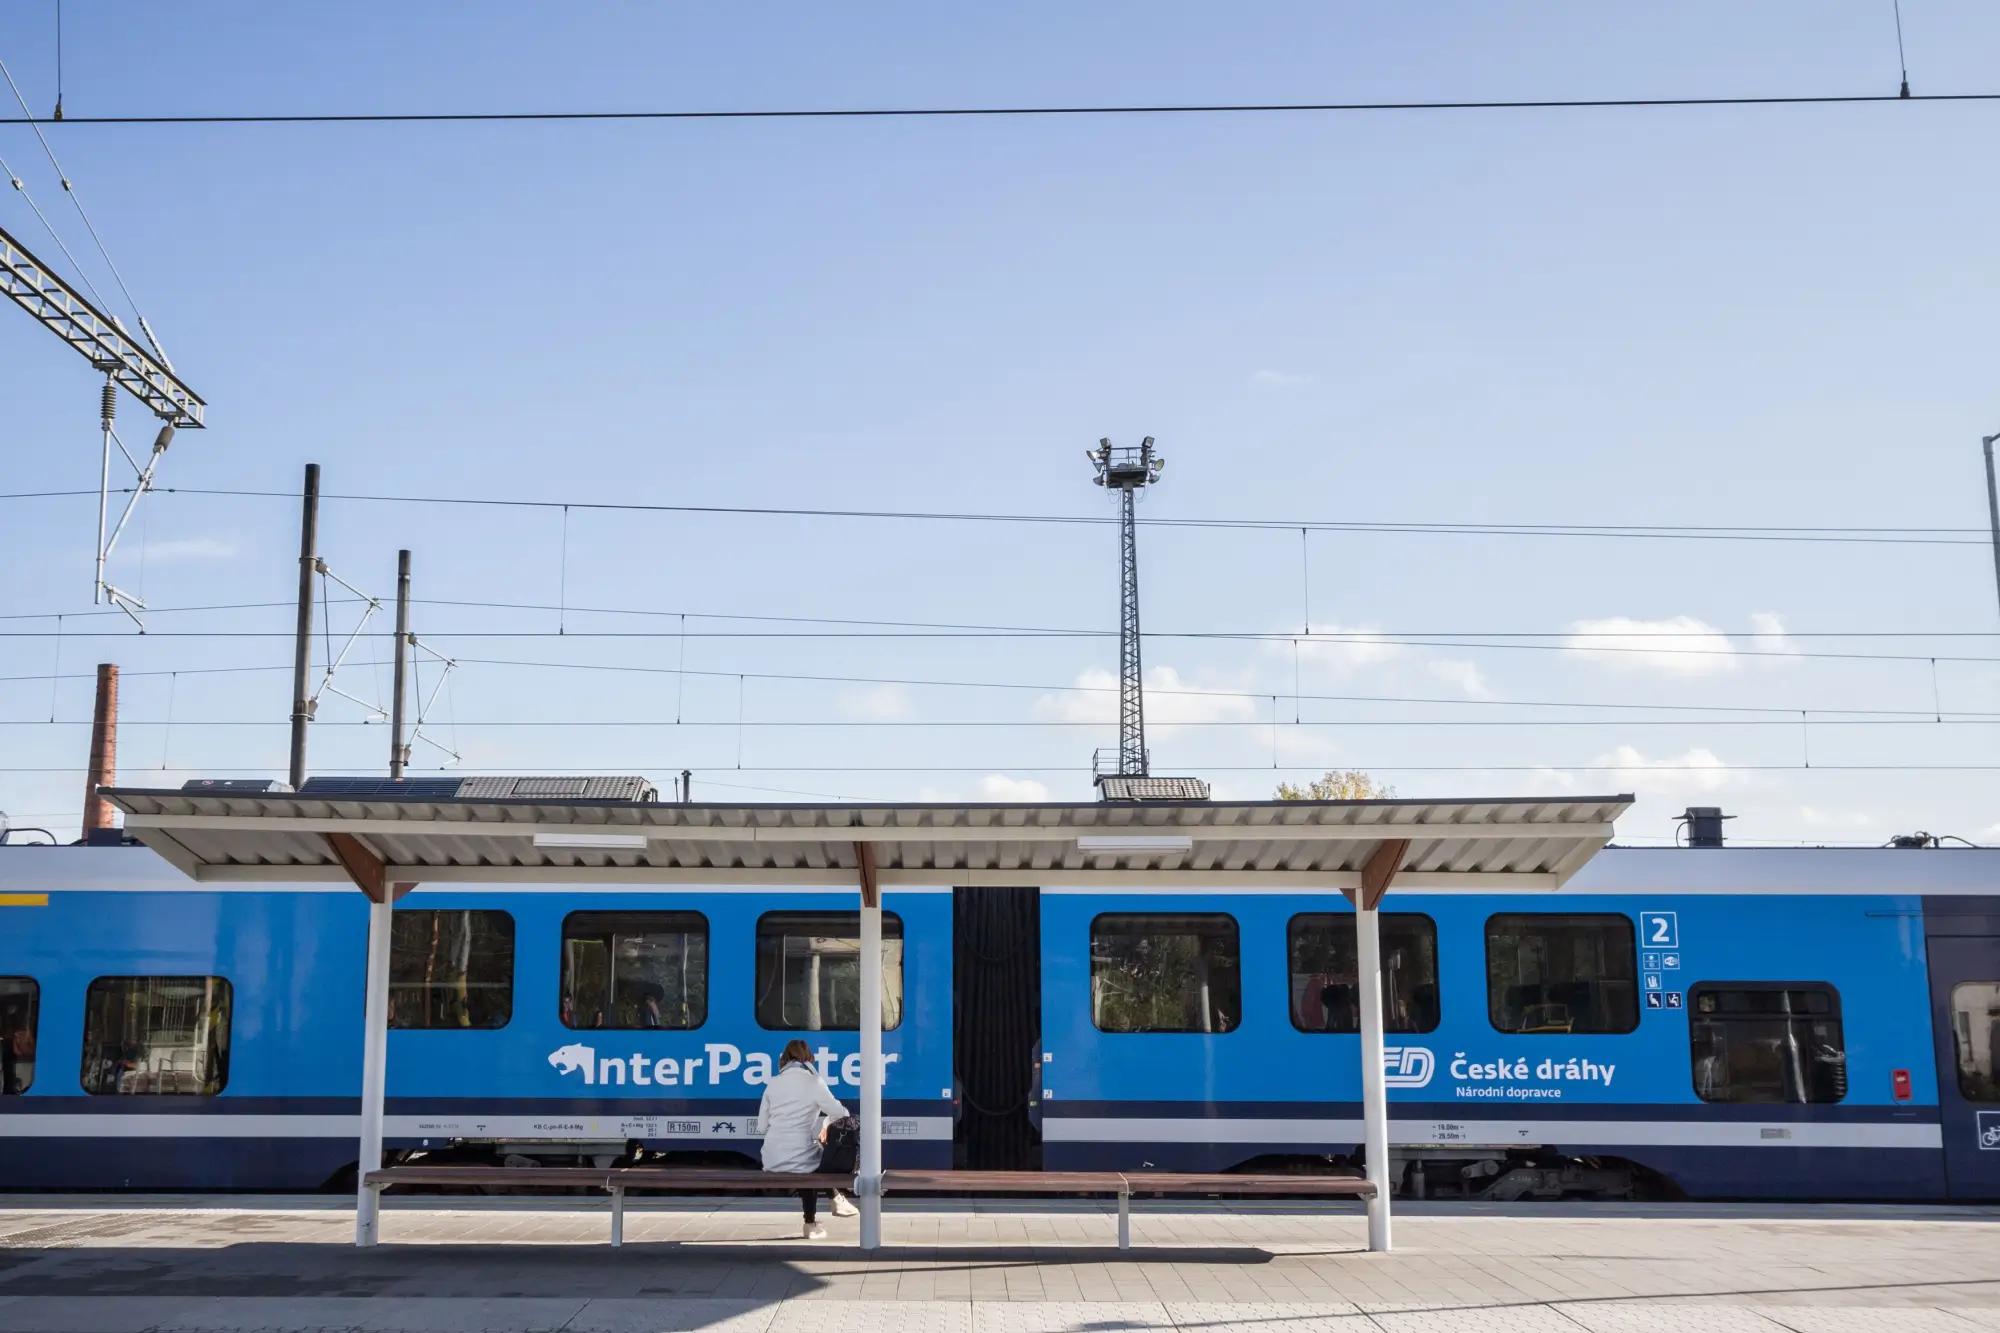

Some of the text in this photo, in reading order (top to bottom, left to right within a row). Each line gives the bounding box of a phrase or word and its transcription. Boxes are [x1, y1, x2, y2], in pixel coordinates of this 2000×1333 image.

[1651, 918, 1670, 942] 2
[548, 1043, 897, 1086] InterPater
[1450, 1051, 1616, 1086] České dráhy
[1456, 1086, 1561, 1100] Národní dopravce
[669, 1123, 699, 1132] R 150m
